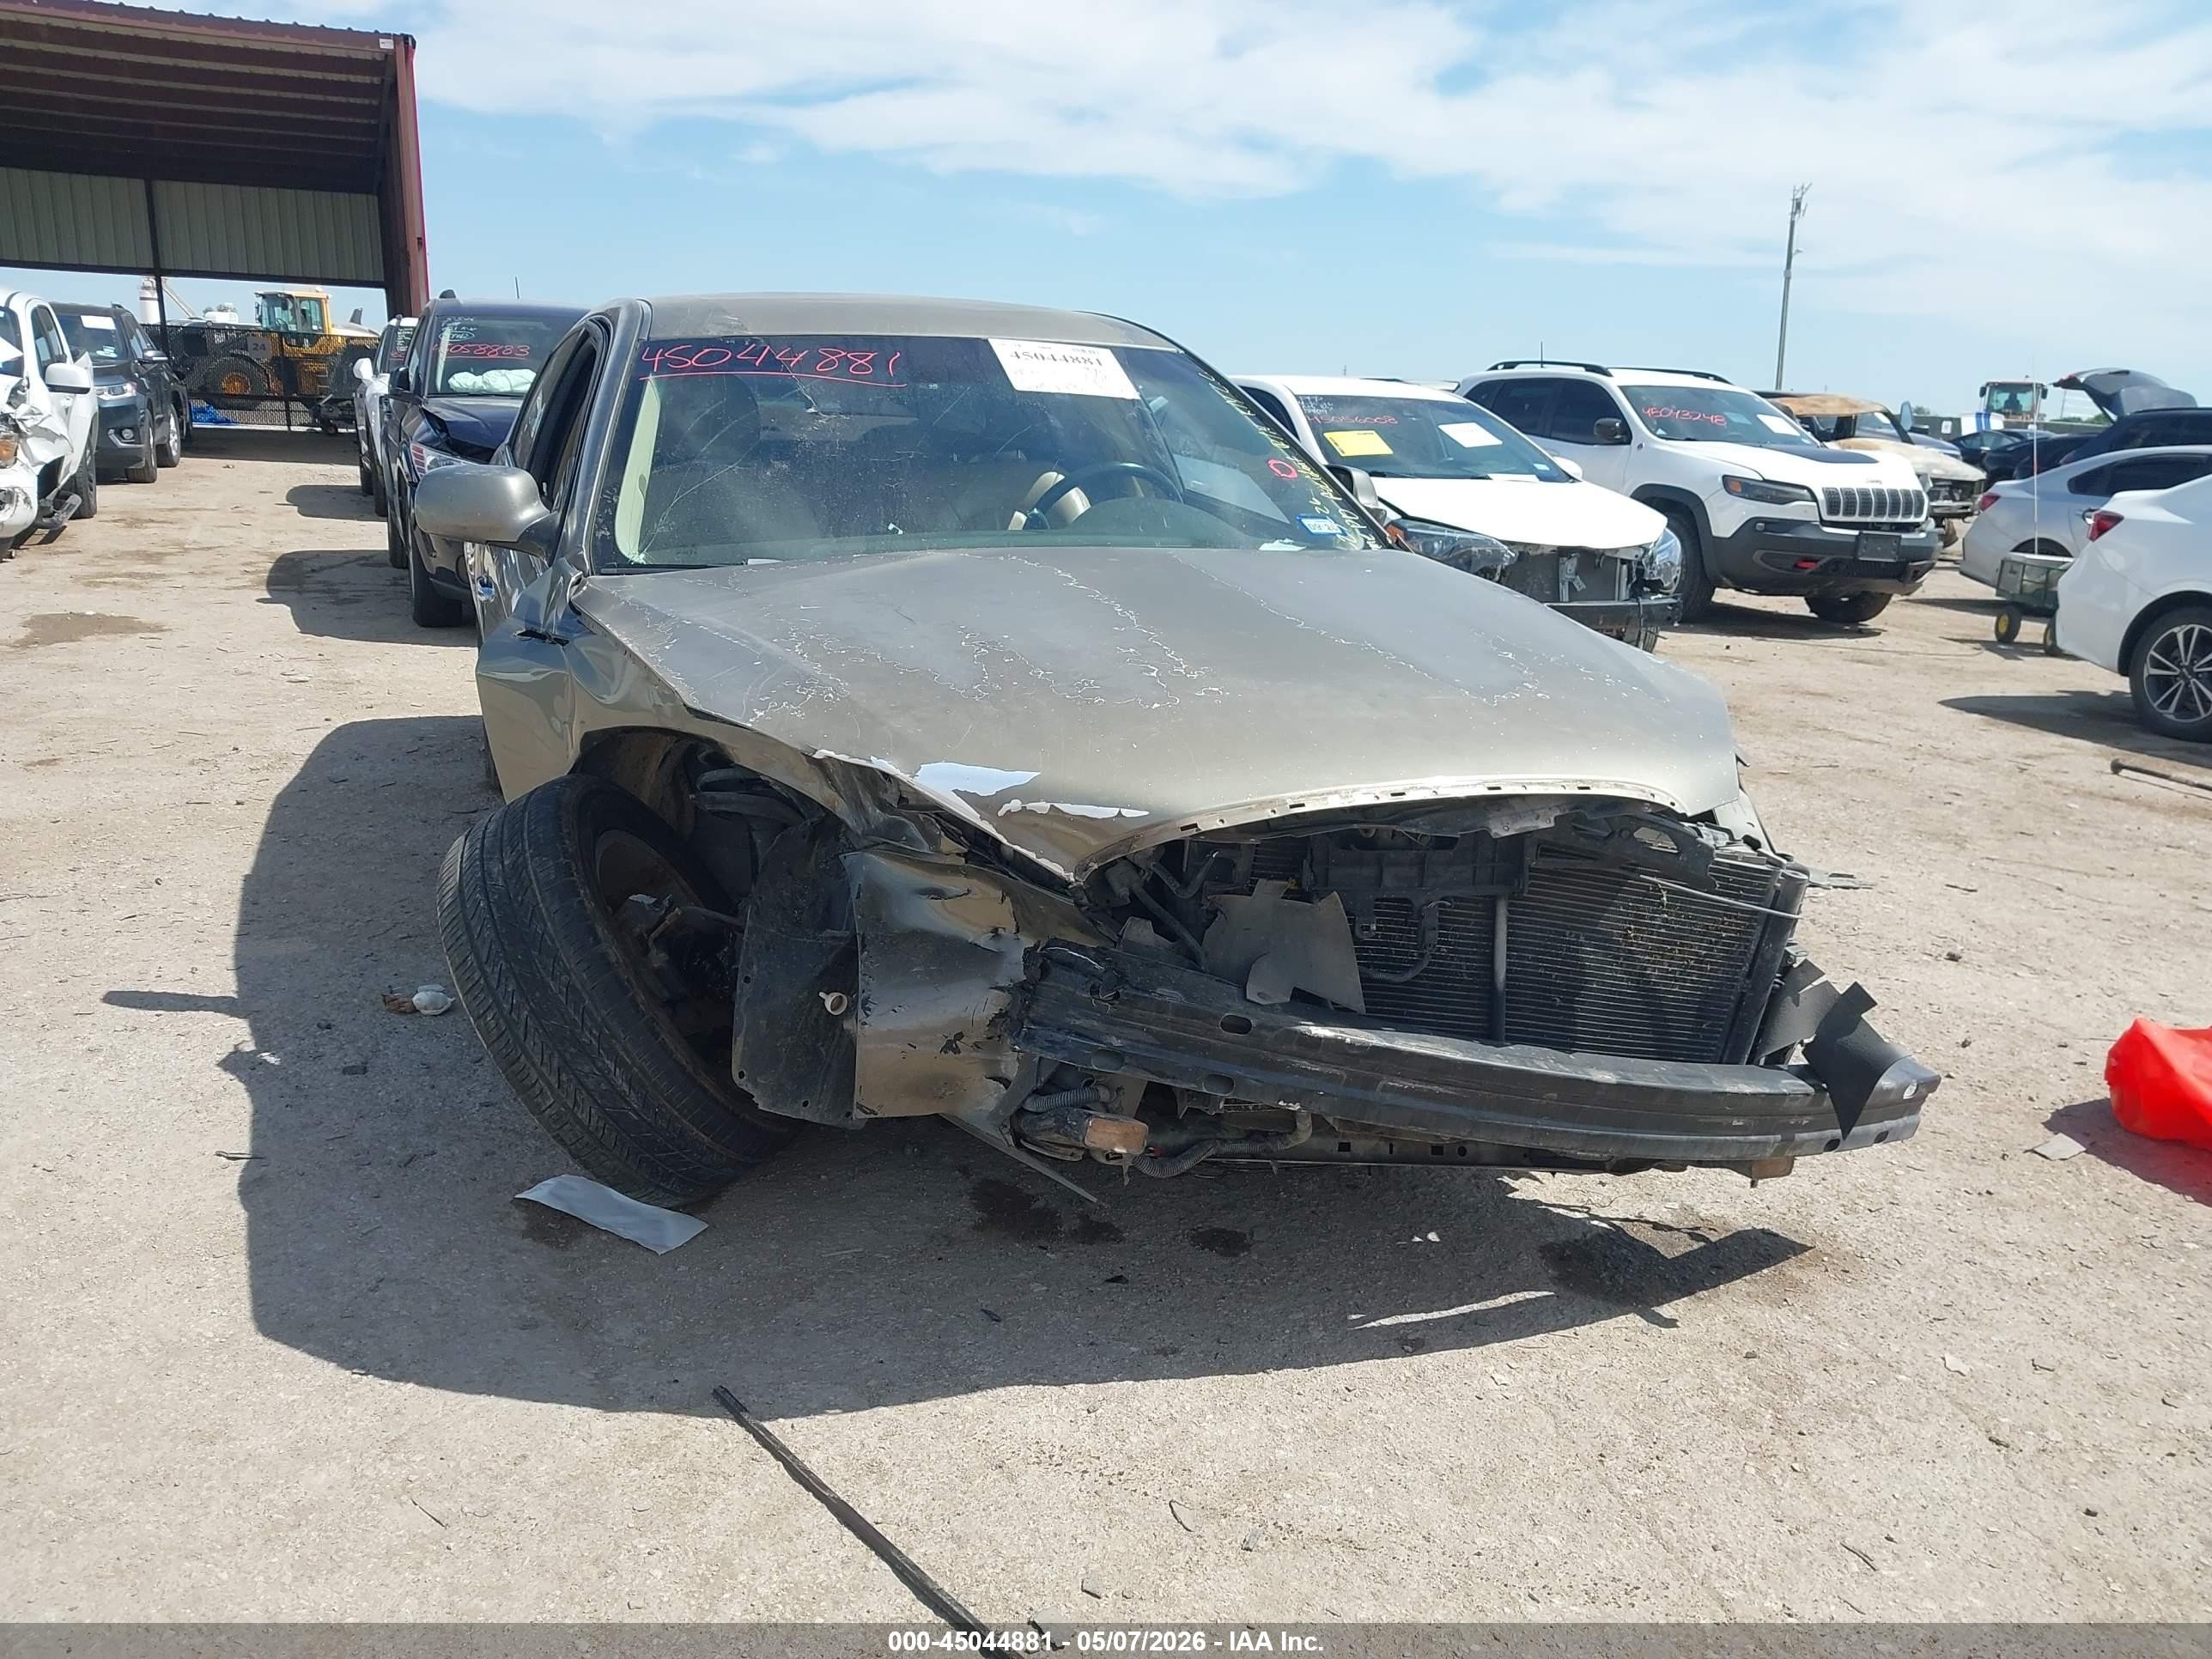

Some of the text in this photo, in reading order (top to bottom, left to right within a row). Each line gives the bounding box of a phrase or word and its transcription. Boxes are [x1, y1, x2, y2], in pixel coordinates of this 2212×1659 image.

[252, 343, 267, 351] 24
[641, 342, 902, 378] 45044881
[1642, 407, 1728, 426] 45043248
